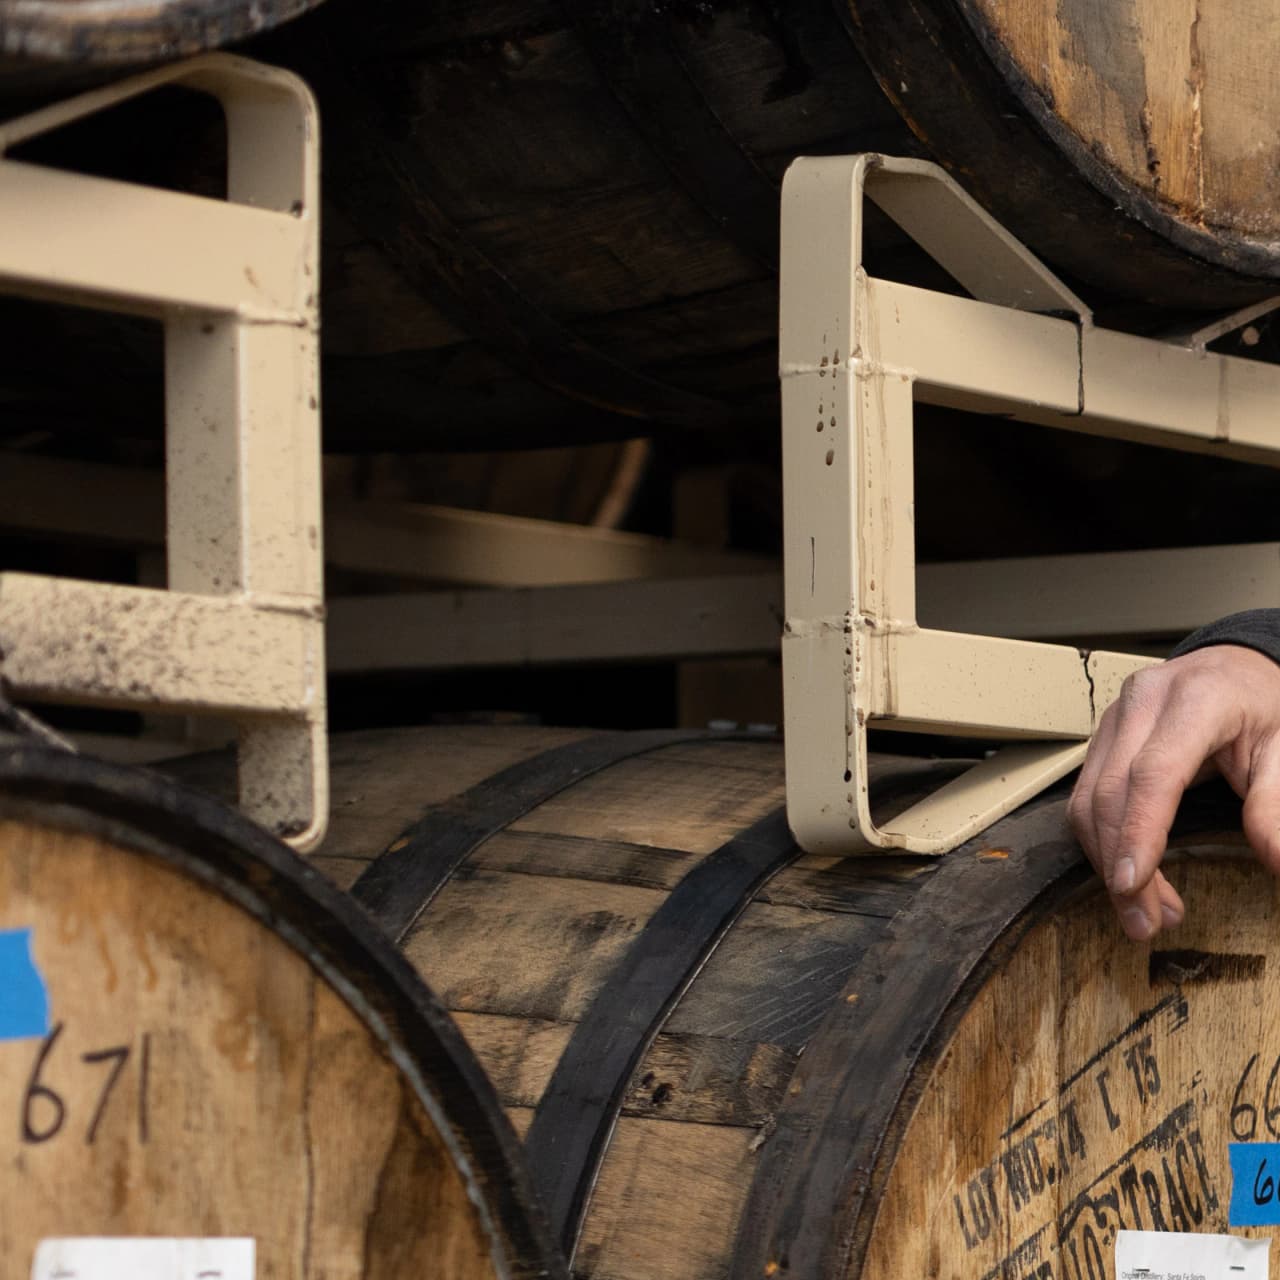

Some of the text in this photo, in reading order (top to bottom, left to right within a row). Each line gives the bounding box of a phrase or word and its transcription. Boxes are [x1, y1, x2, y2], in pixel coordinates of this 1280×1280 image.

[21, 1021, 153, 1145] 671
[953, 1160, 1001, 1252] LOT
[1167, 1273, 1181, 1280] Santa
